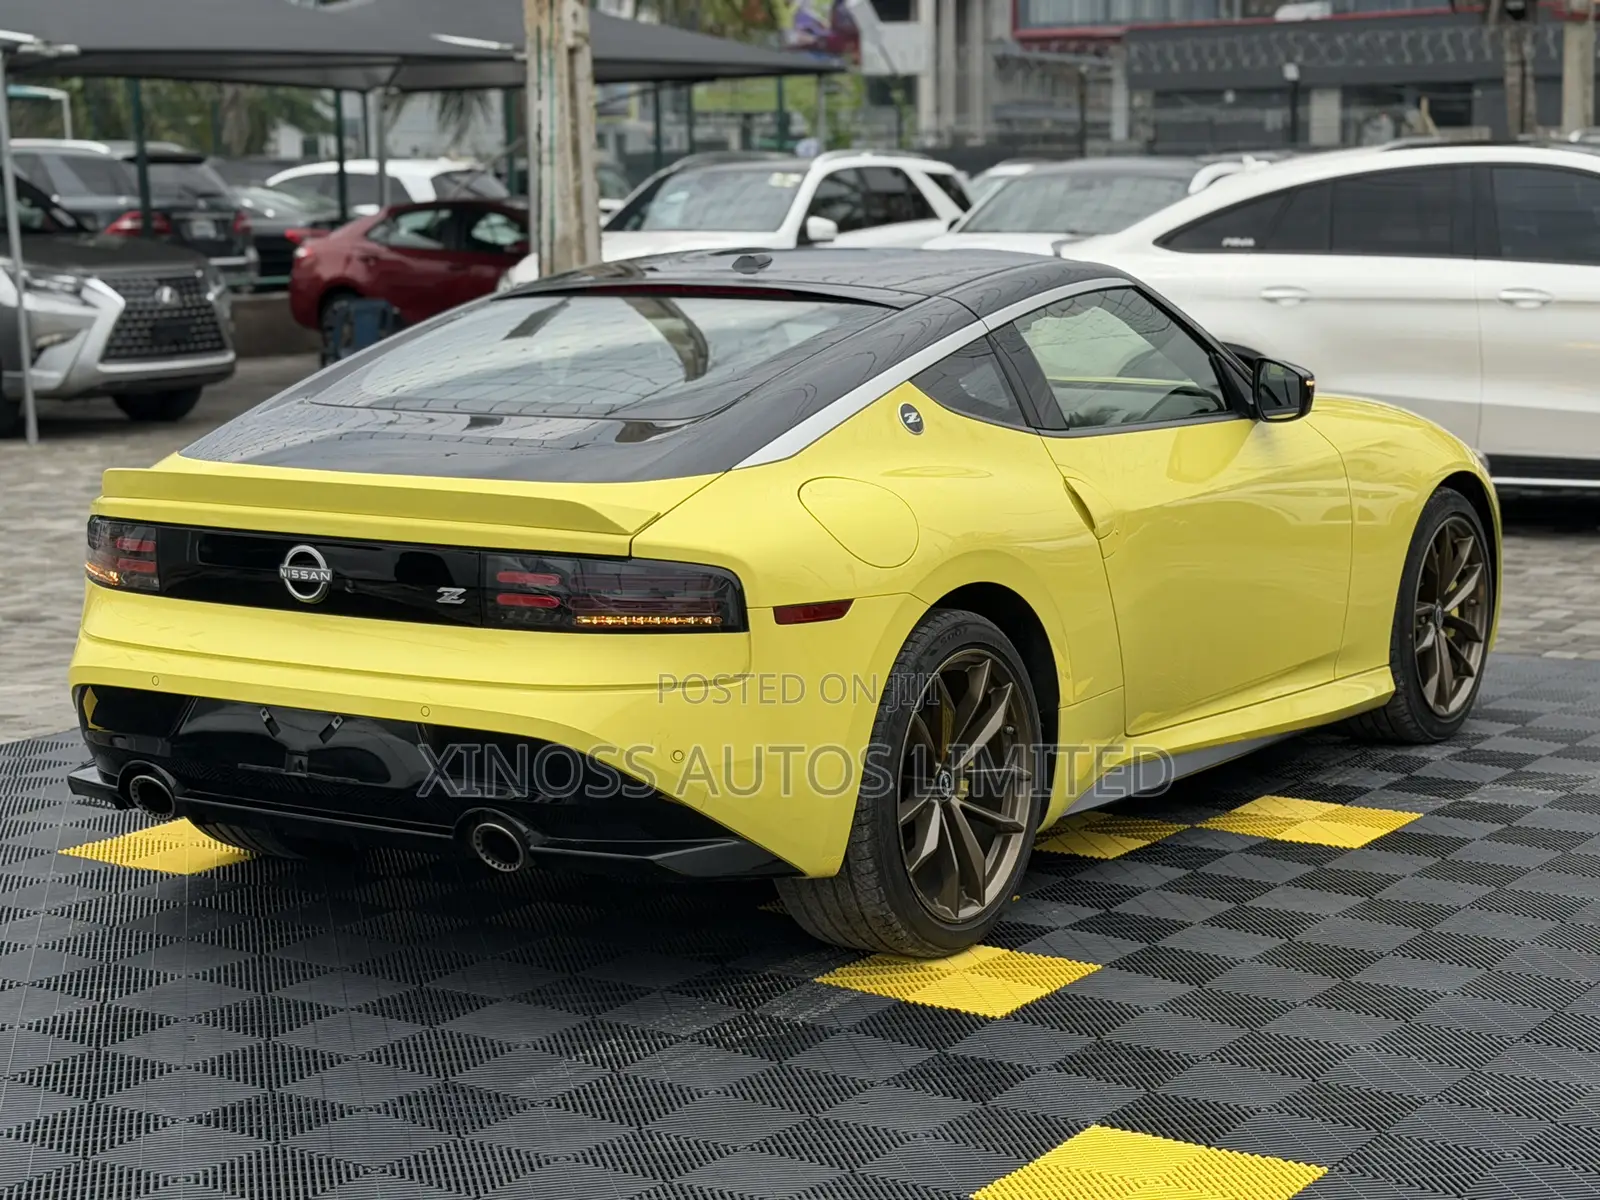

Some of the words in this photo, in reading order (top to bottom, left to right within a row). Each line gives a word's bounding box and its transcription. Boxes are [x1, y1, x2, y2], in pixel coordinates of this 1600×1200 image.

[904, 412, 920, 424] Z
[279, 567, 332, 582] NISSAN
[436, 587, 467, 604] Z
